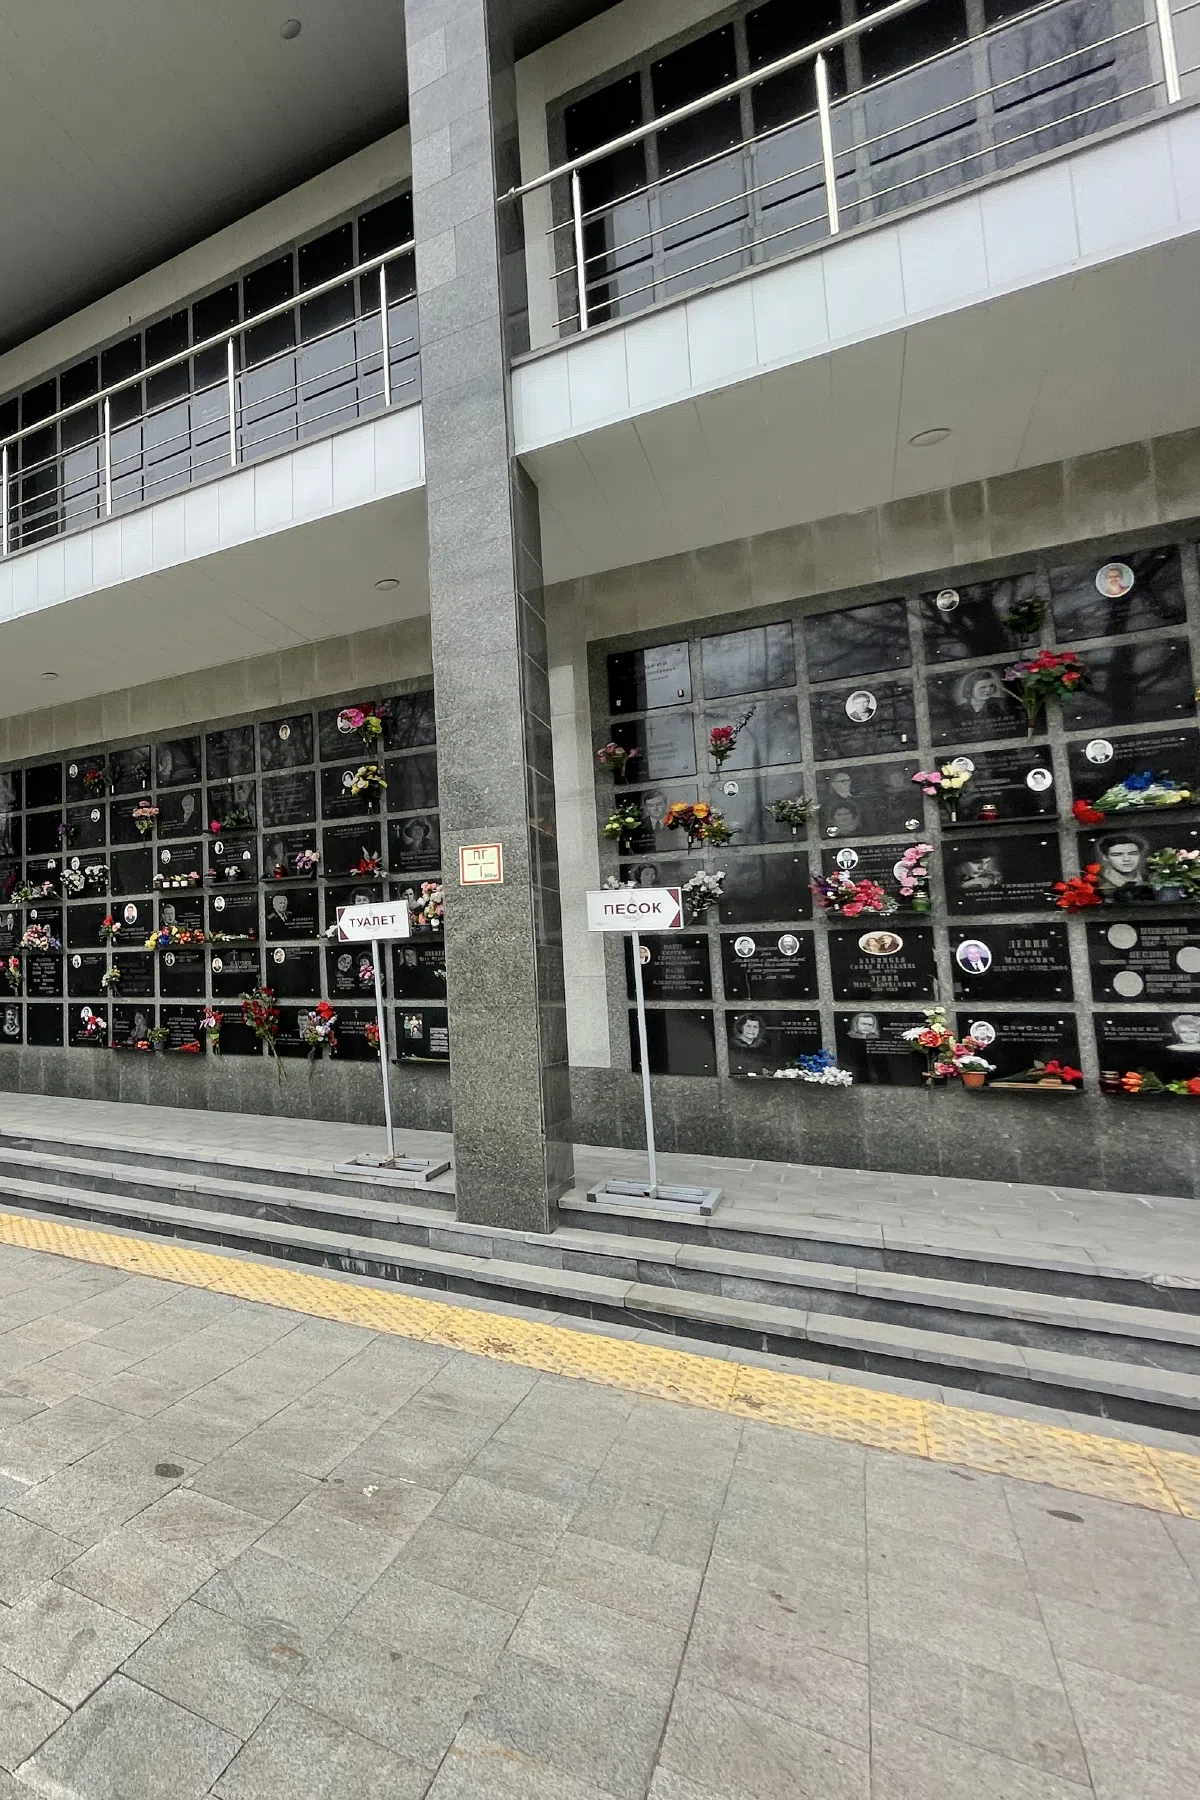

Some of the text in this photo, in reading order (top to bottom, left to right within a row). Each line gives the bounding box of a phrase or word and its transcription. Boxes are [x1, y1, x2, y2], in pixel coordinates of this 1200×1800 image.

[473, 849, 488, 860] ПГ
[603, 902, 662, 915] ПЕСОК
[348, 914, 397, 928] ТУАЛЕТ
